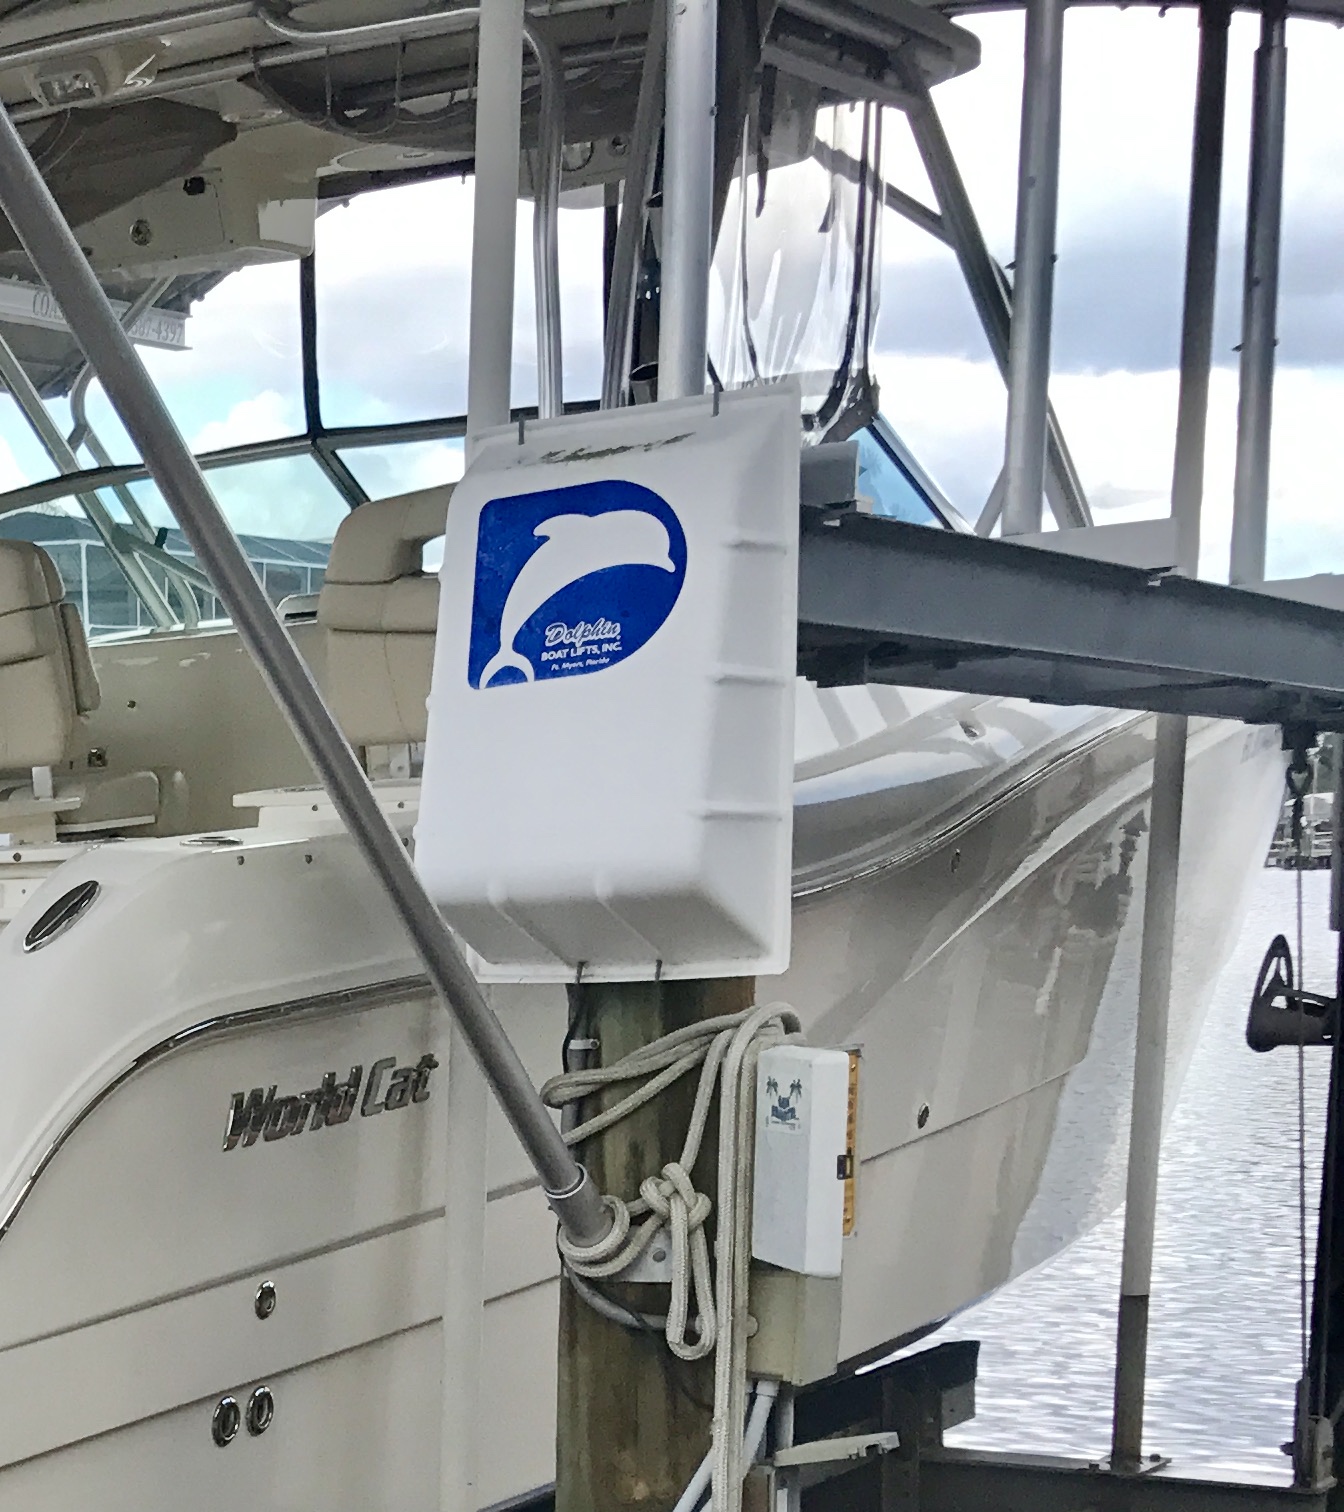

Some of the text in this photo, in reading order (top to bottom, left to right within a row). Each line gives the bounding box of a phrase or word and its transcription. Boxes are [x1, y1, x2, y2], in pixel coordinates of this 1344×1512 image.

[545, 617, 621, 647] Dolphin
[540, 648, 569, 661] BOAT
[222, 1053, 439, 1152] World Cat
